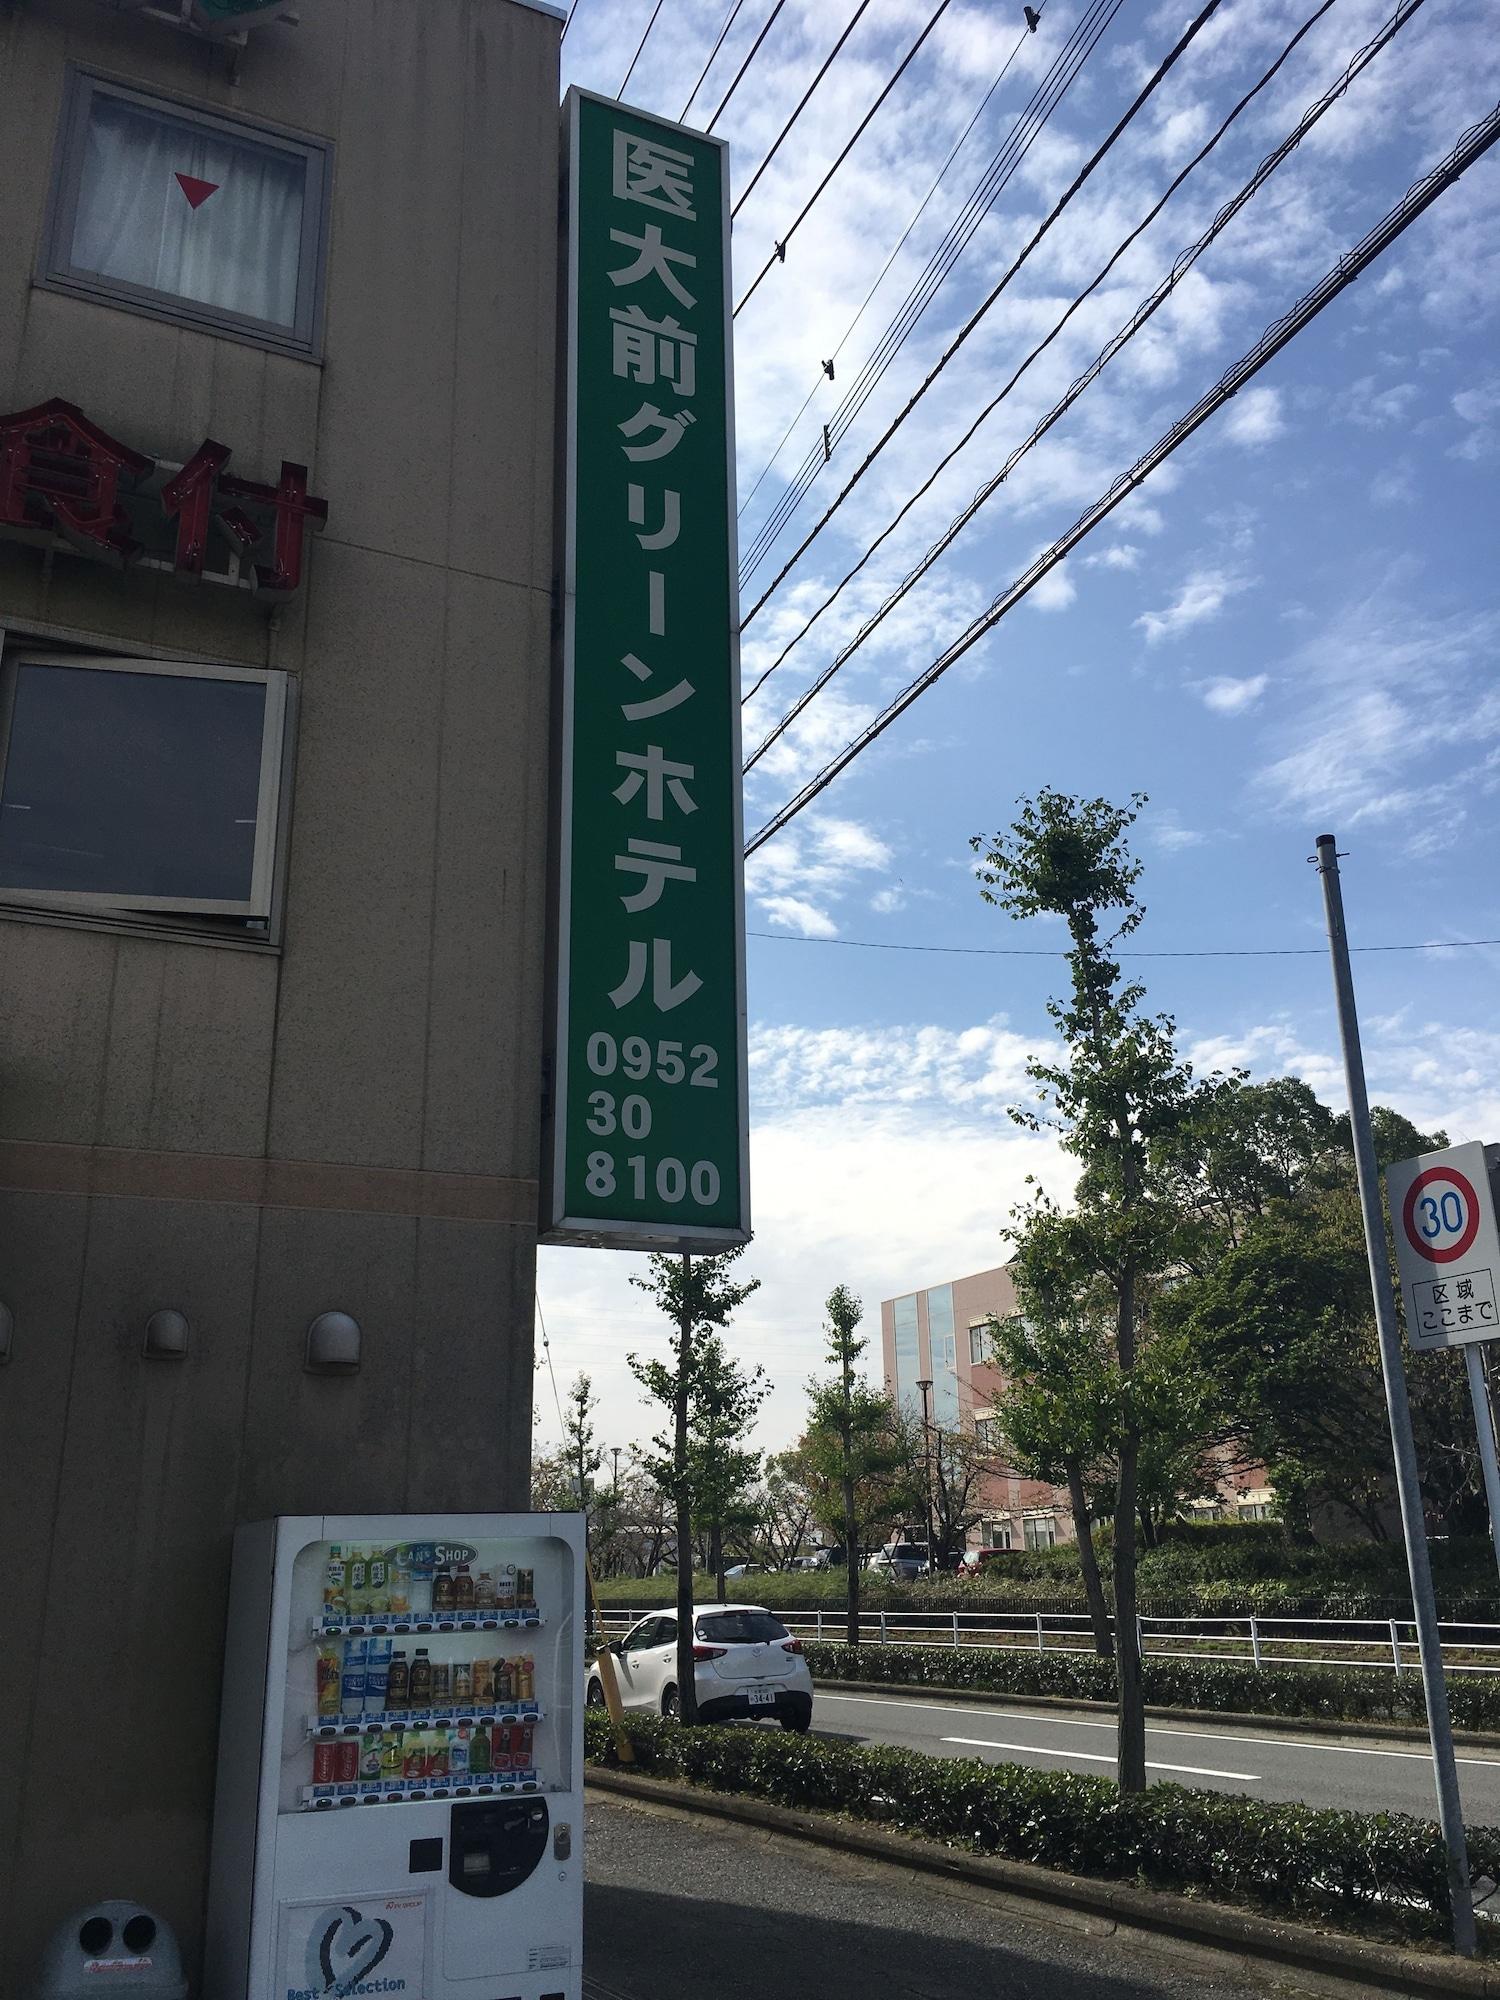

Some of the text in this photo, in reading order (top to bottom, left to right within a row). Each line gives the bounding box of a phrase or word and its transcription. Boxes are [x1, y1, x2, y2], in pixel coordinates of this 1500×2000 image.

[606, 128, 704, 1013] 医大前グリーンホテル
[586, 1031, 720, 1089] 0952
[585, 1091, 653, 1140] 30
[585, 1151, 721, 1206] 8100
[1420, 1191, 1464, 1238] 30
[1422, 1300, 1493, 1330] ここまで
[1432, 1278, 1475, 1305] 区域
[434, 1546, 469, 1565] SHOP
[287, 1978, 406, 2000] Best Selection
